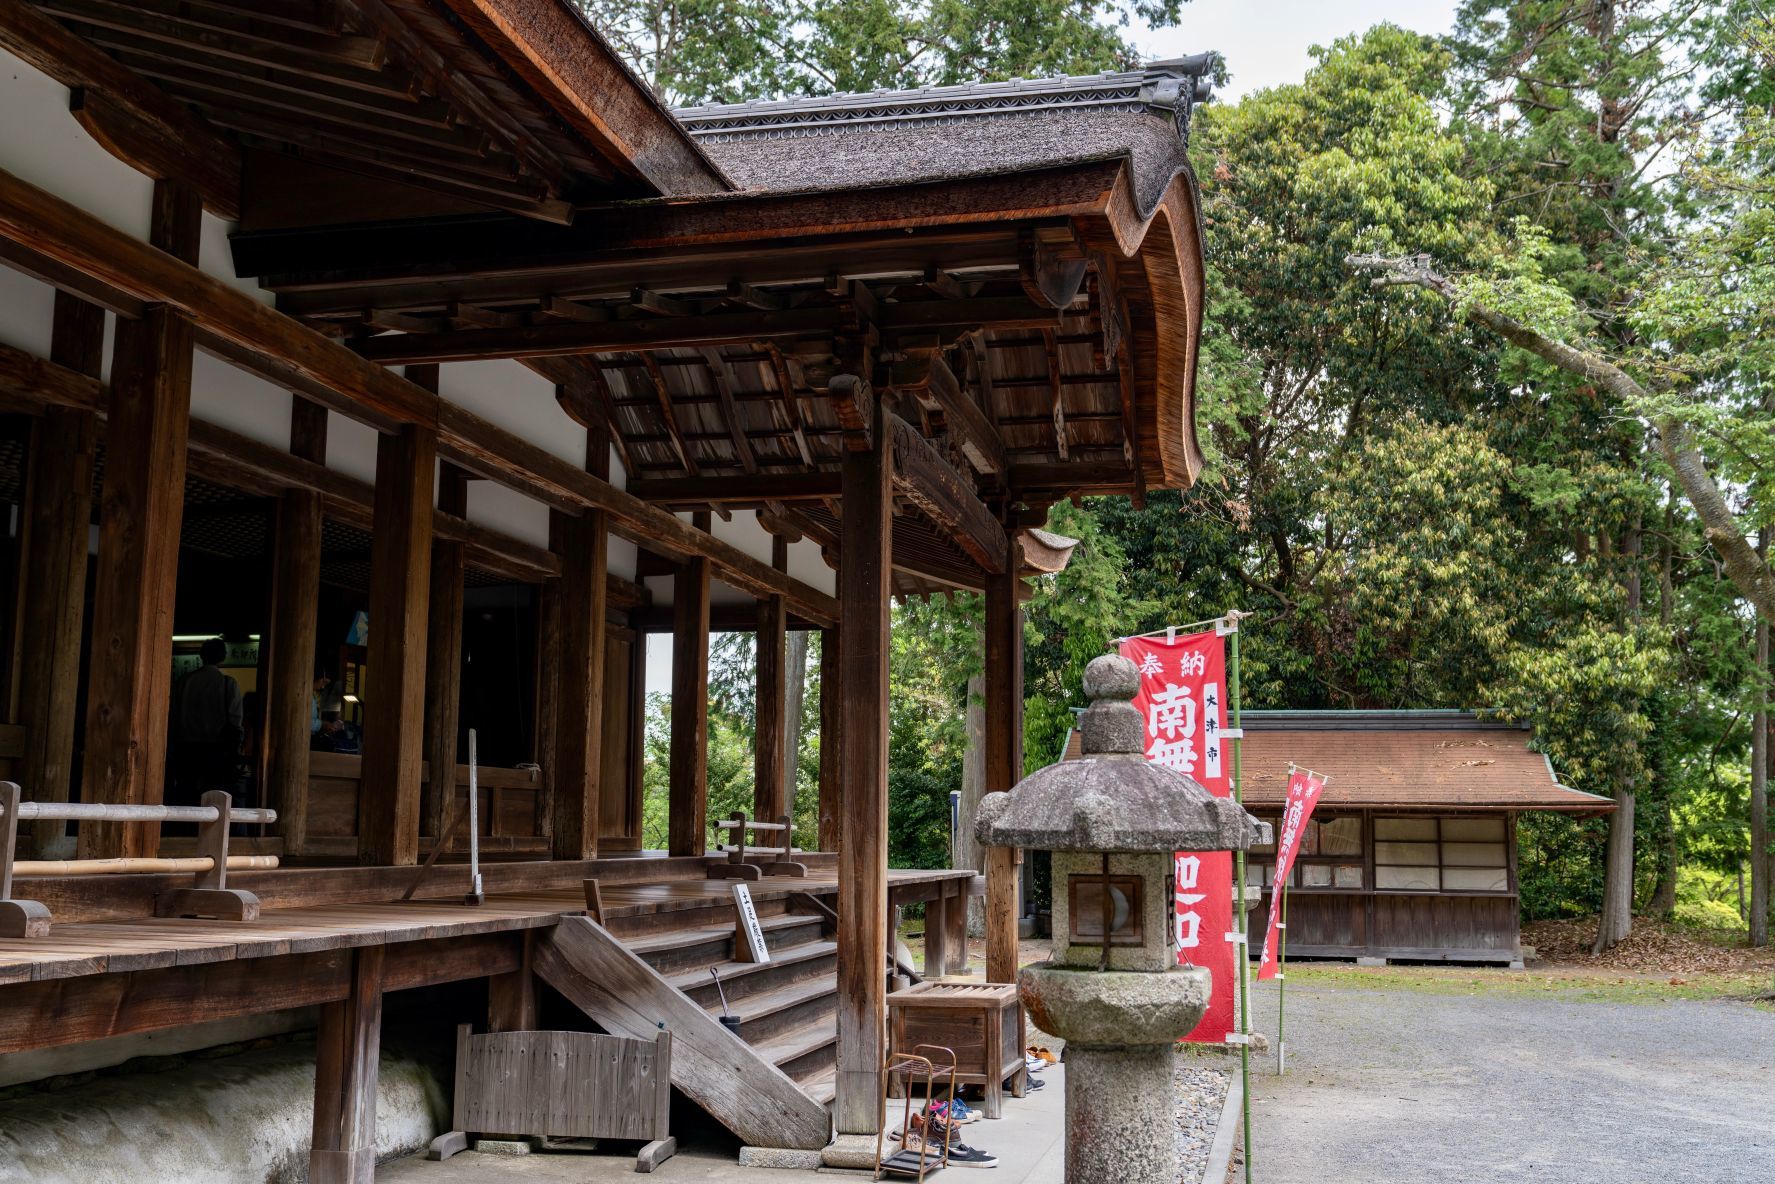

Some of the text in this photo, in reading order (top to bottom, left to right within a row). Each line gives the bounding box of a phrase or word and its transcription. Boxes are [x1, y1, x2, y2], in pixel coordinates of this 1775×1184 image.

[1140, 651, 1205, 679] 奉納
[1205, 694, 1218, 762] 大津市
